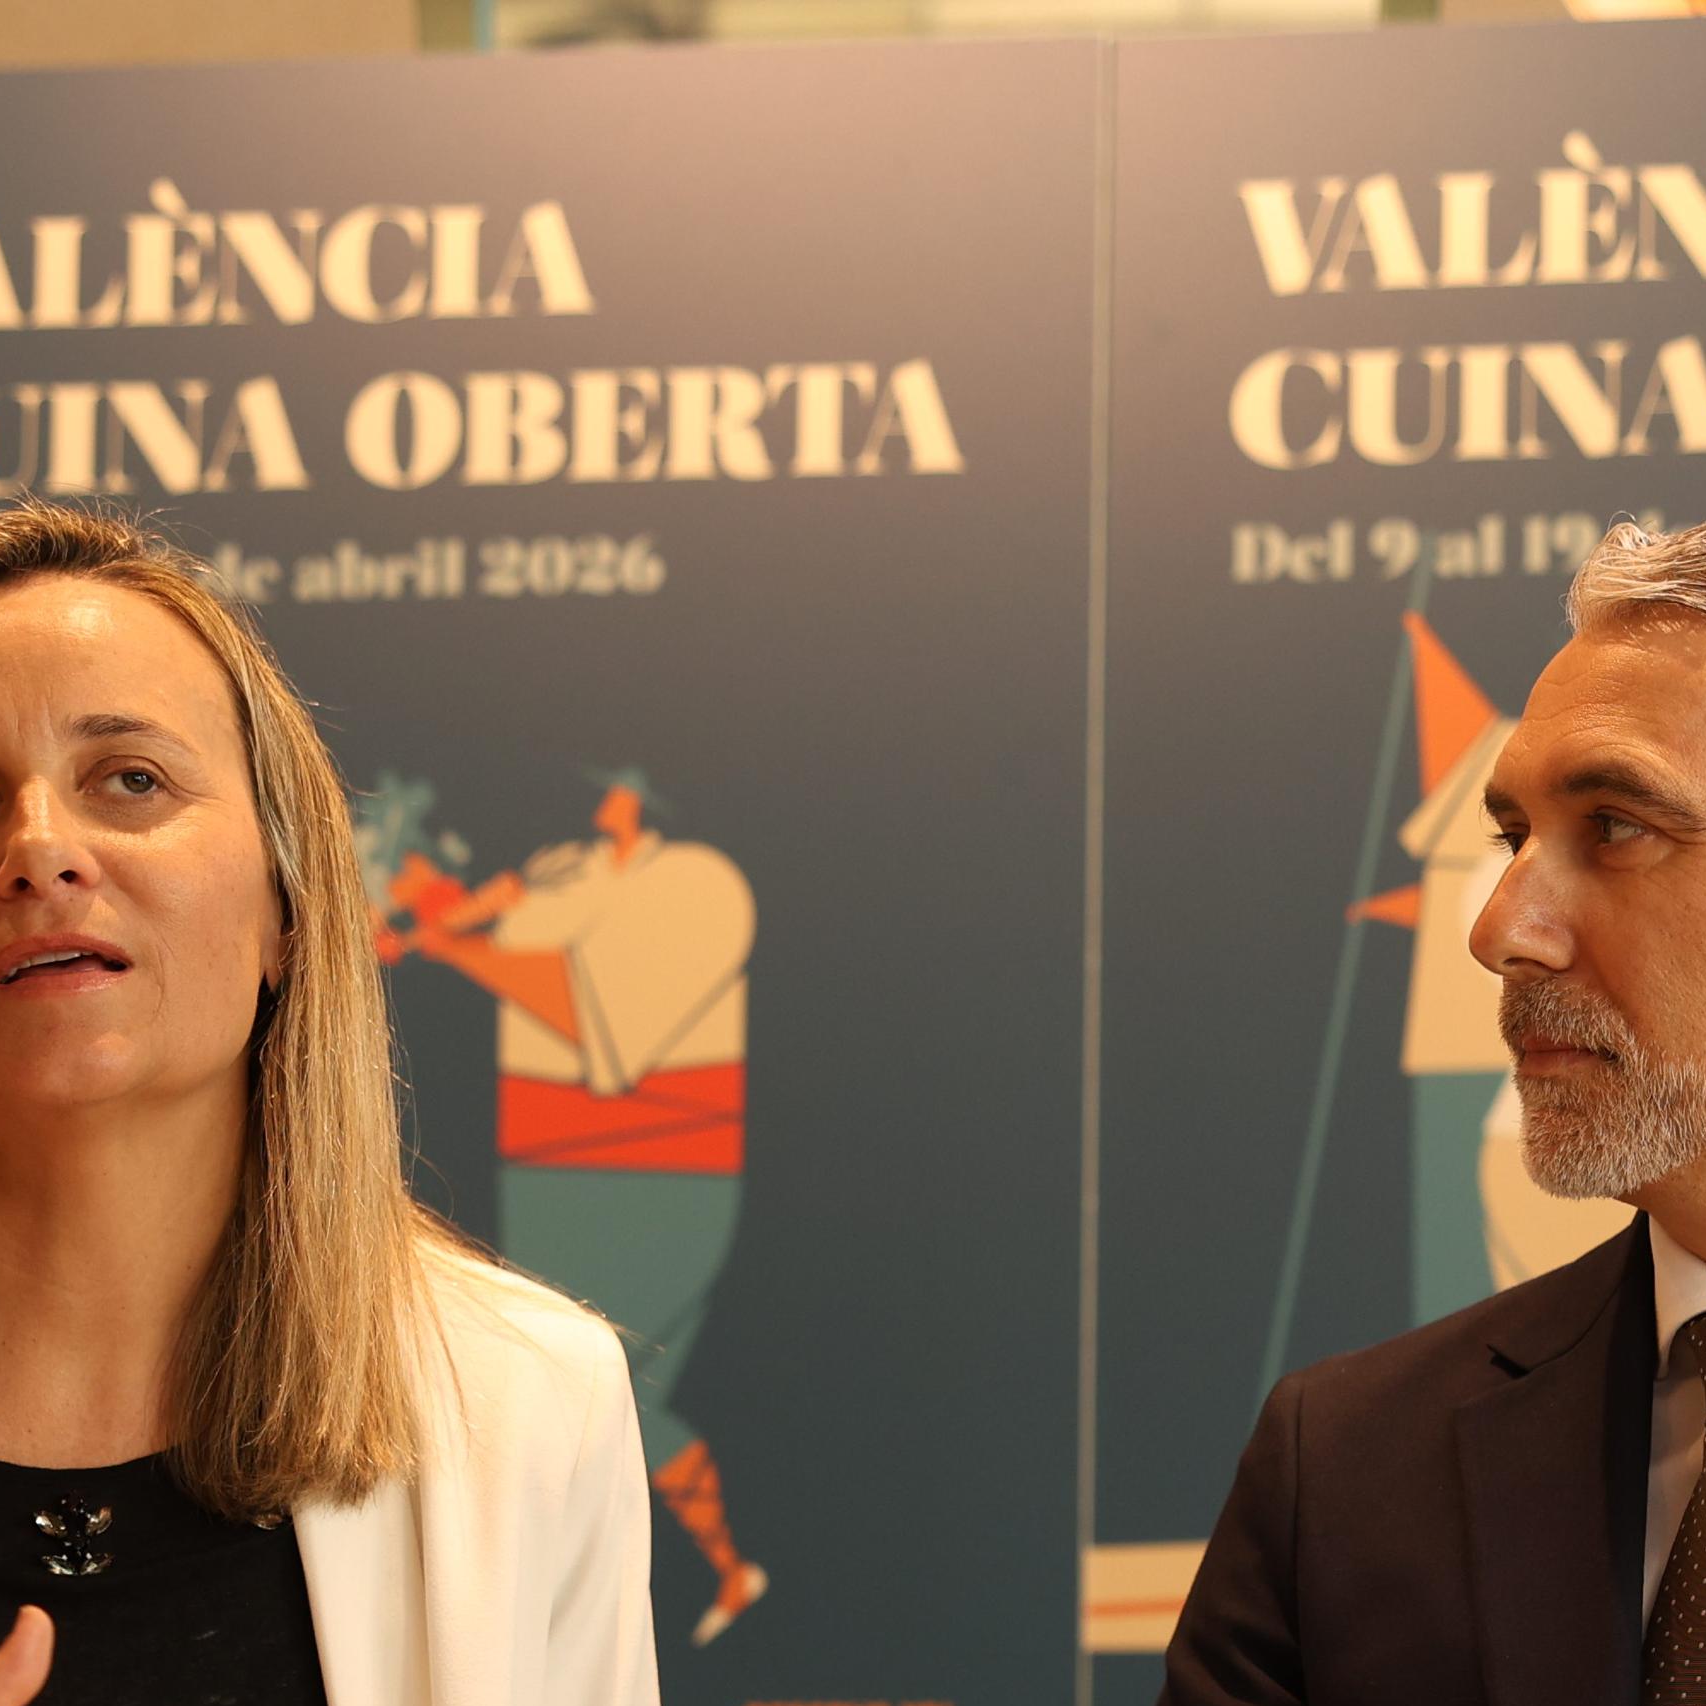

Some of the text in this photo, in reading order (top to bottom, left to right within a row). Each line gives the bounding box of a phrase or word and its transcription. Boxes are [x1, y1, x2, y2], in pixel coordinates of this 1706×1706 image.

[343, 356, 967, 492] OBERTA
[292, 535, 467, 602] abril
[479, 532, 667, 598] 2026
[1230, 518, 1356, 584] Del
[1368, 517, 1422, 579] 9
[1434, 512, 1506, 578] al
